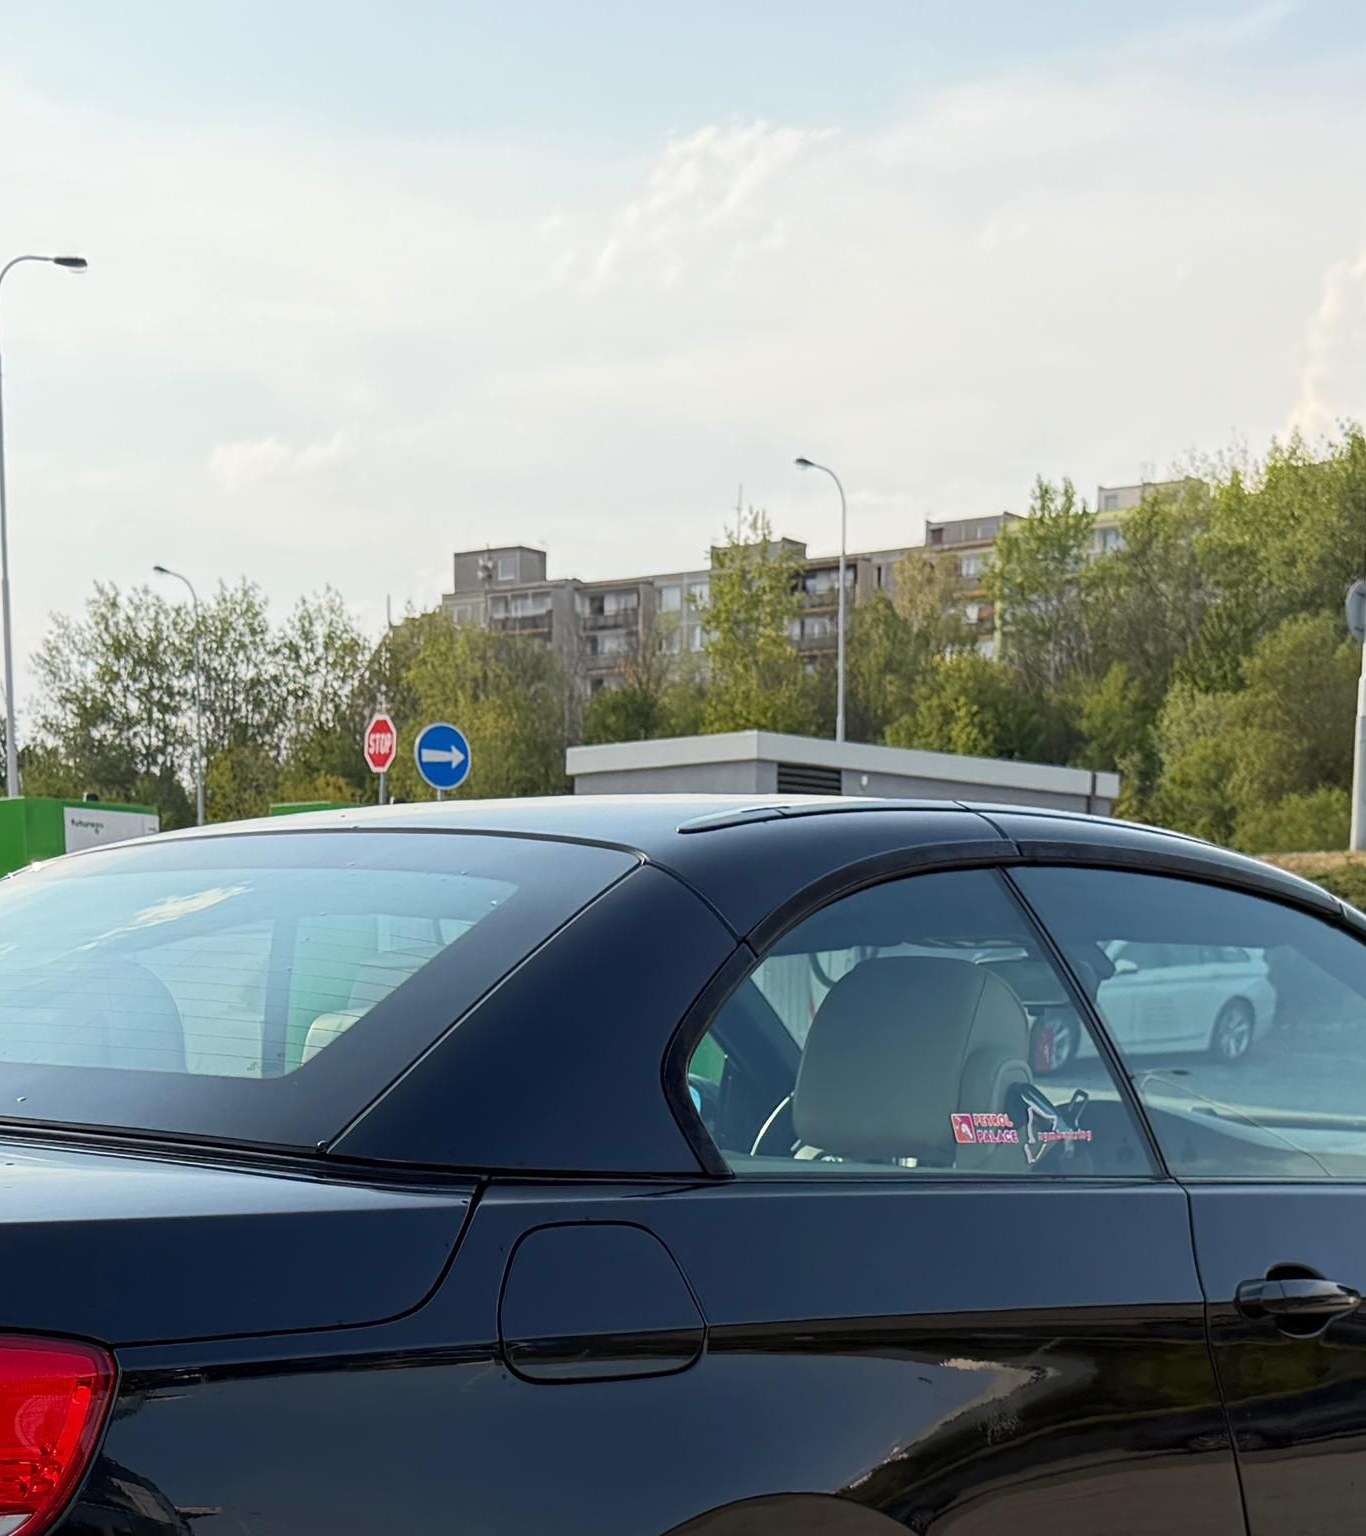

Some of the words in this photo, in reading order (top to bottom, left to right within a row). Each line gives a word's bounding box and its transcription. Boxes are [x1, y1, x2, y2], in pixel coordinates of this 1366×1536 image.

[368, 732, 393, 754] STOP
[972, 1113, 1014, 1128] PETROL
[976, 1129, 1020, 1143] PALACE
